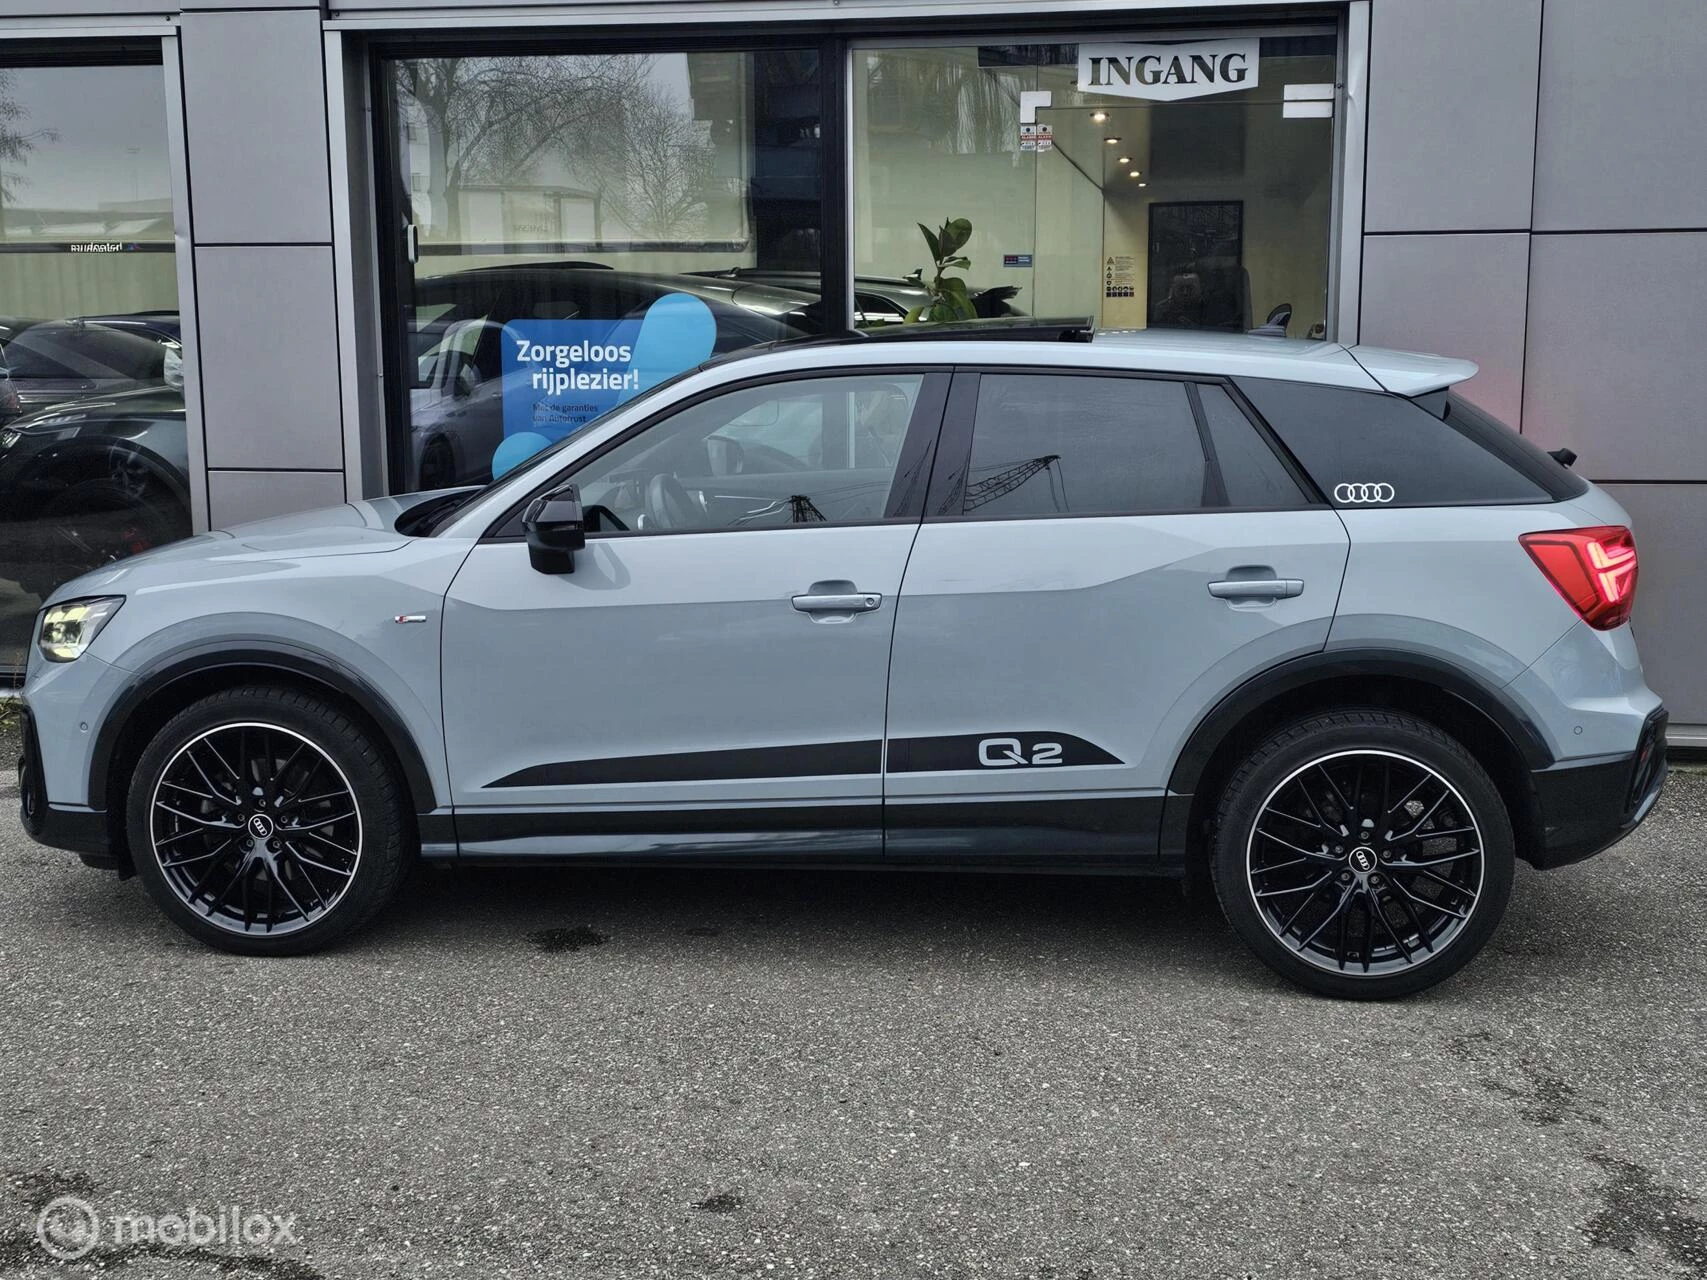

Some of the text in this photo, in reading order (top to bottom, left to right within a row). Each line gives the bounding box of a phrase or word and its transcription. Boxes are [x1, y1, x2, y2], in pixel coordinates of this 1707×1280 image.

[1088, 53, 1248, 85] INGANG
[516, 340, 631, 368] Zorgeloos
[532, 367, 639, 395] rijplezier!
[550, 403, 560, 411] de
[562, 403, 598, 414] garanties
[979, 738, 1063, 766] Q2
